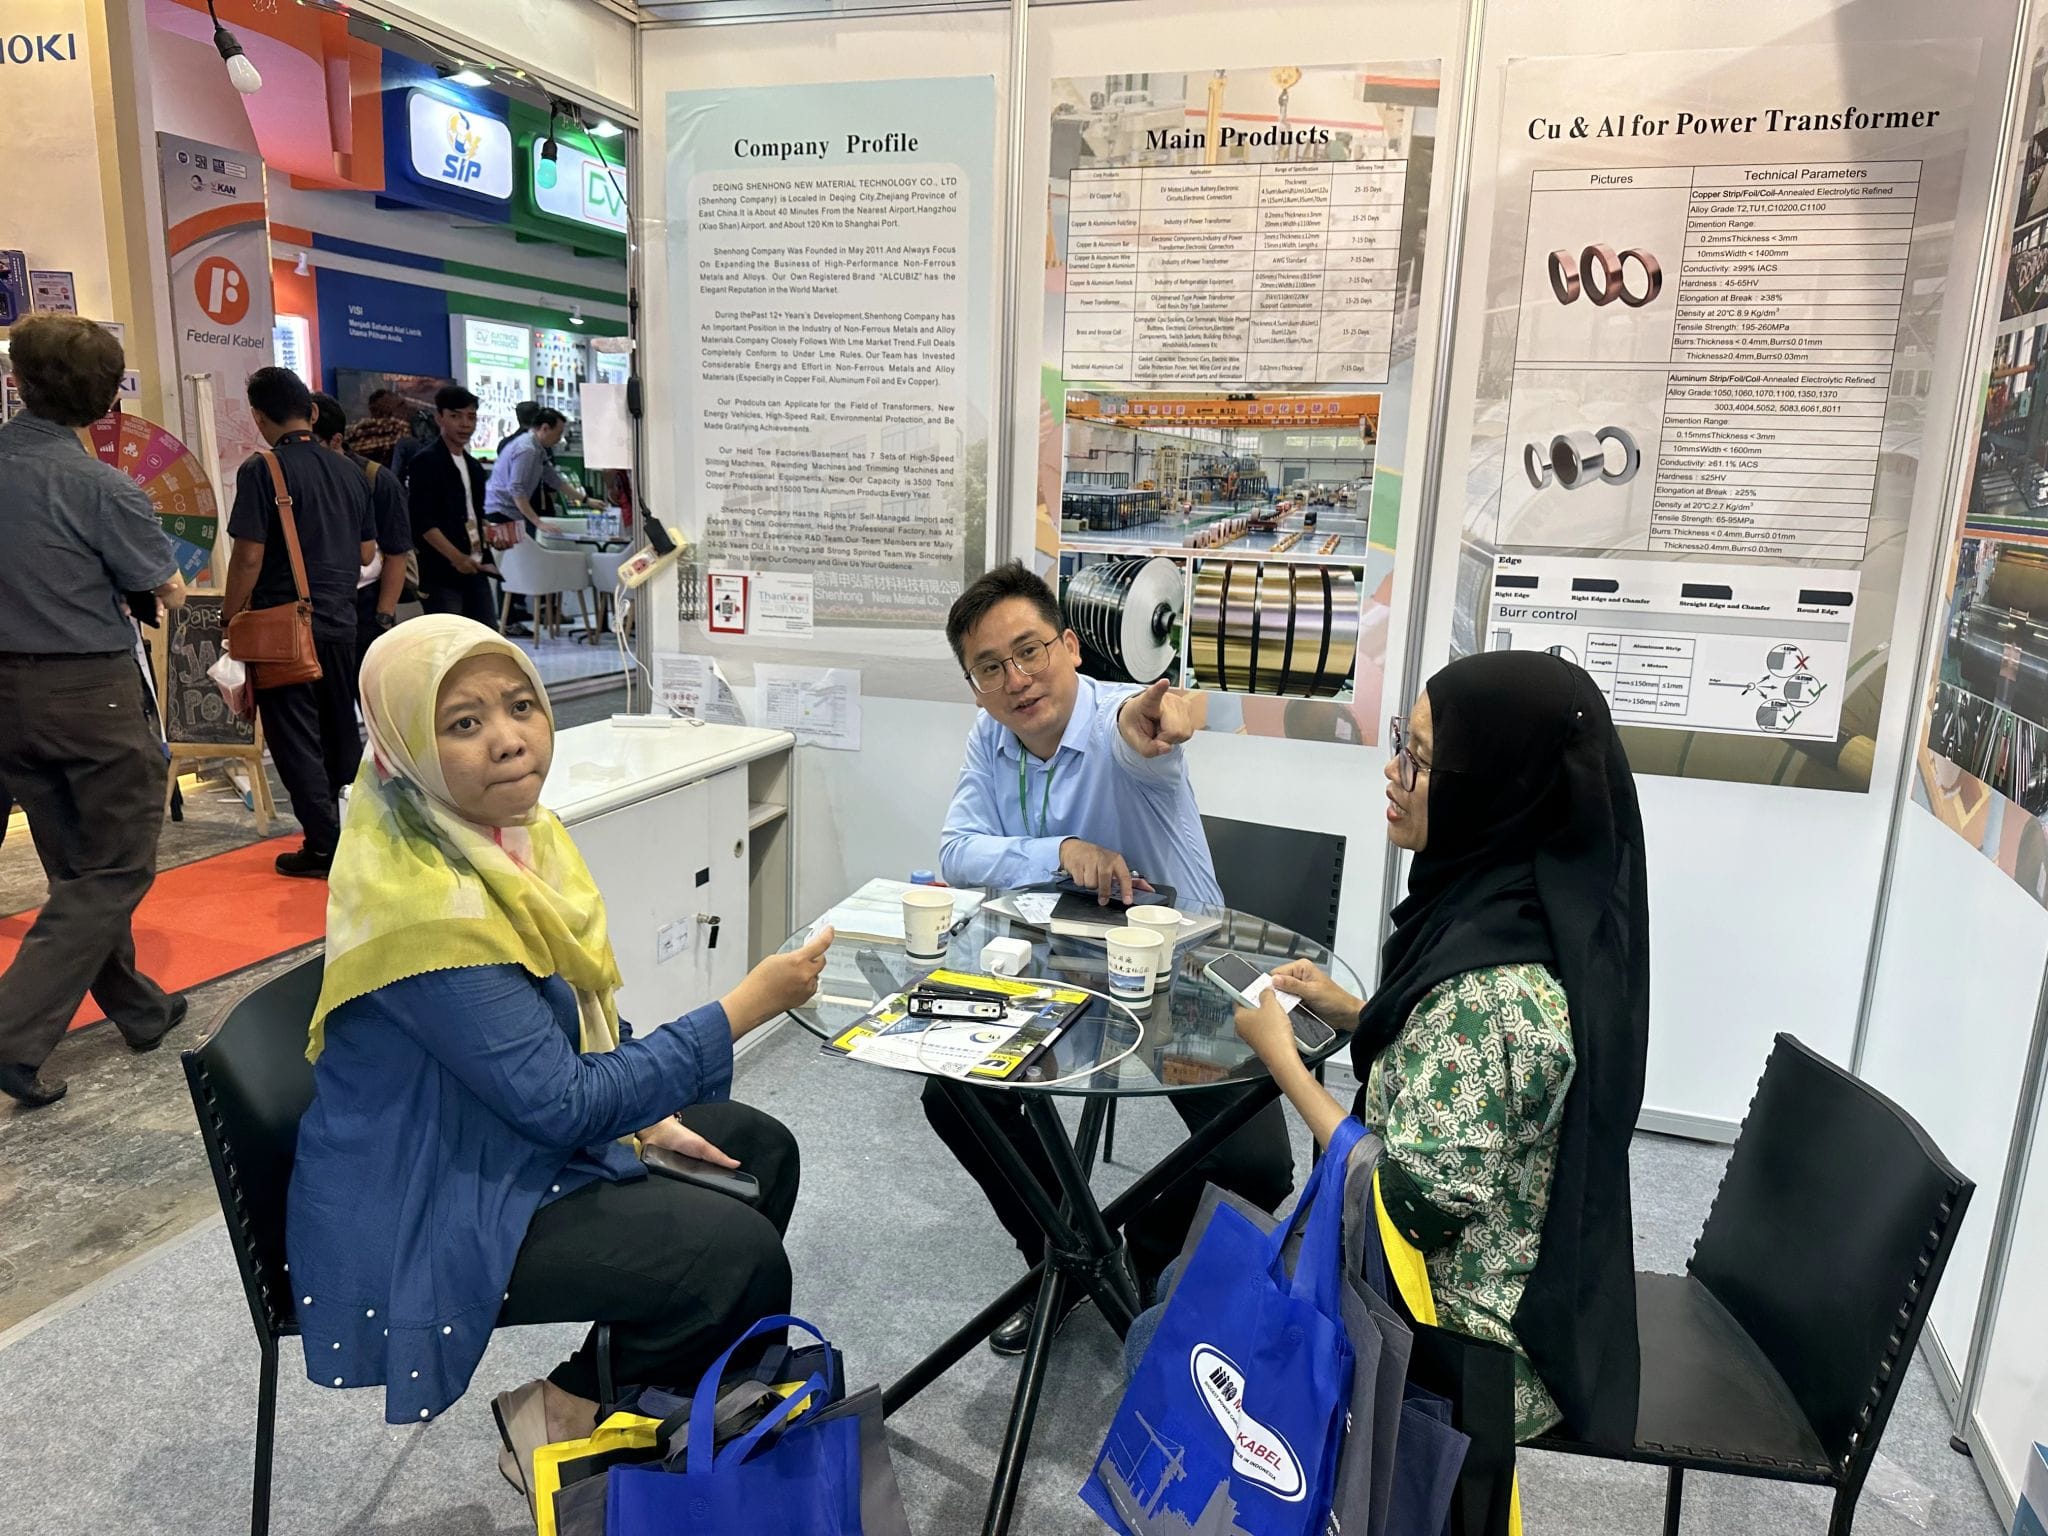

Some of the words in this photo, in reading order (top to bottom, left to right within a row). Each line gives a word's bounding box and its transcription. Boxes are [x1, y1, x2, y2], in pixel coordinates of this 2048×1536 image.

[1528, 118, 1561, 141] Cu
[1569, 116, 1589, 138] &
[1631, 114, 1669, 137] for
[1676, 112, 1757, 135] Power
[1765, 107, 1940, 132] Transformer
[1146, 129, 1205, 149] Main
[1219, 125, 1329, 148] Products
[734, 139, 829, 160] Company
[847, 133, 918, 153] Profile
[1590, 173, 1633, 186] Pictures
[1744, 170, 1798, 181] Technical
[1801, 168, 1867, 179] Parameters
[746, 182, 791, 190] SHENHONG
[795, 181, 812, 189] NEW
[816, 180, 856, 188] MATERIAL
[859, 179, 917, 187] TECHNOLOGY
[941, 178, 957, 186] LTD
[1692, 190, 1721, 199] Copper
[1817, 187, 1860, 196] Electrolytic
[740, 195, 777, 204] Company)
[830, 194, 856, 202] Deqing
[912, 192, 945, 200] Province
[857, 206, 886, 214] Nearest
[845, 220, 880, 229] Shanghai
[1688, 220, 1726, 228] Dimention
[714, 248, 749, 256] Shenhong
[752, 247, 785, 256] Company
[849, 246, 864, 255] May
[903, 246, 930, 255] Always
[933, 245, 956, 253] Focus
[1756, 249, 1788, 257] 1400mm
[775, 260, 809, 268] Business
[825, 259, 898, 268] High-Performance
[904, 259, 956, 267] Non-Ferrous
[1757, 264, 1777, 272] IACS
[809, 273, 850, 282] Registered
[1725, 279, 1759, 287] 45-65HV
[1679, 294, 1719, 303] Elongation
[348, 305, 363, 315] VISI
[893, 325, 918, 333] Metals
[937, 326, 955, 335] Alloy
[1676, 323, 1702, 331] Tensile
[1741, 323, 1789, 331] 195-260MPa
[187, 329, 230, 346] Federal
[232, 334, 264, 349] Kabel
[866, 338, 891, 346] Market
[934, 339, 955, 347] Deals
[923, 352, 955, 360] Invested
[829, 376, 864, 384] Aluminum
[910, 454, 953, 463] High-Speed
[866, 465, 899, 473] Trimming
[904, 466, 938, 474] Machines
[134, 474, 145, 484] 10
[868, 477, 900, 486] Capacity
[936, 479, 953, 487] Tons
[1716, 516, 1754, 524] 65-95MPa
[1499, 557, 1522, 565] Edge
[1680, 600, 1707, 608] Straight
[1500, 607, 1527, 618] Burr
[1532, 610, 1577, 620] control
[1237, 1431, 1282, 1471] KABEL
